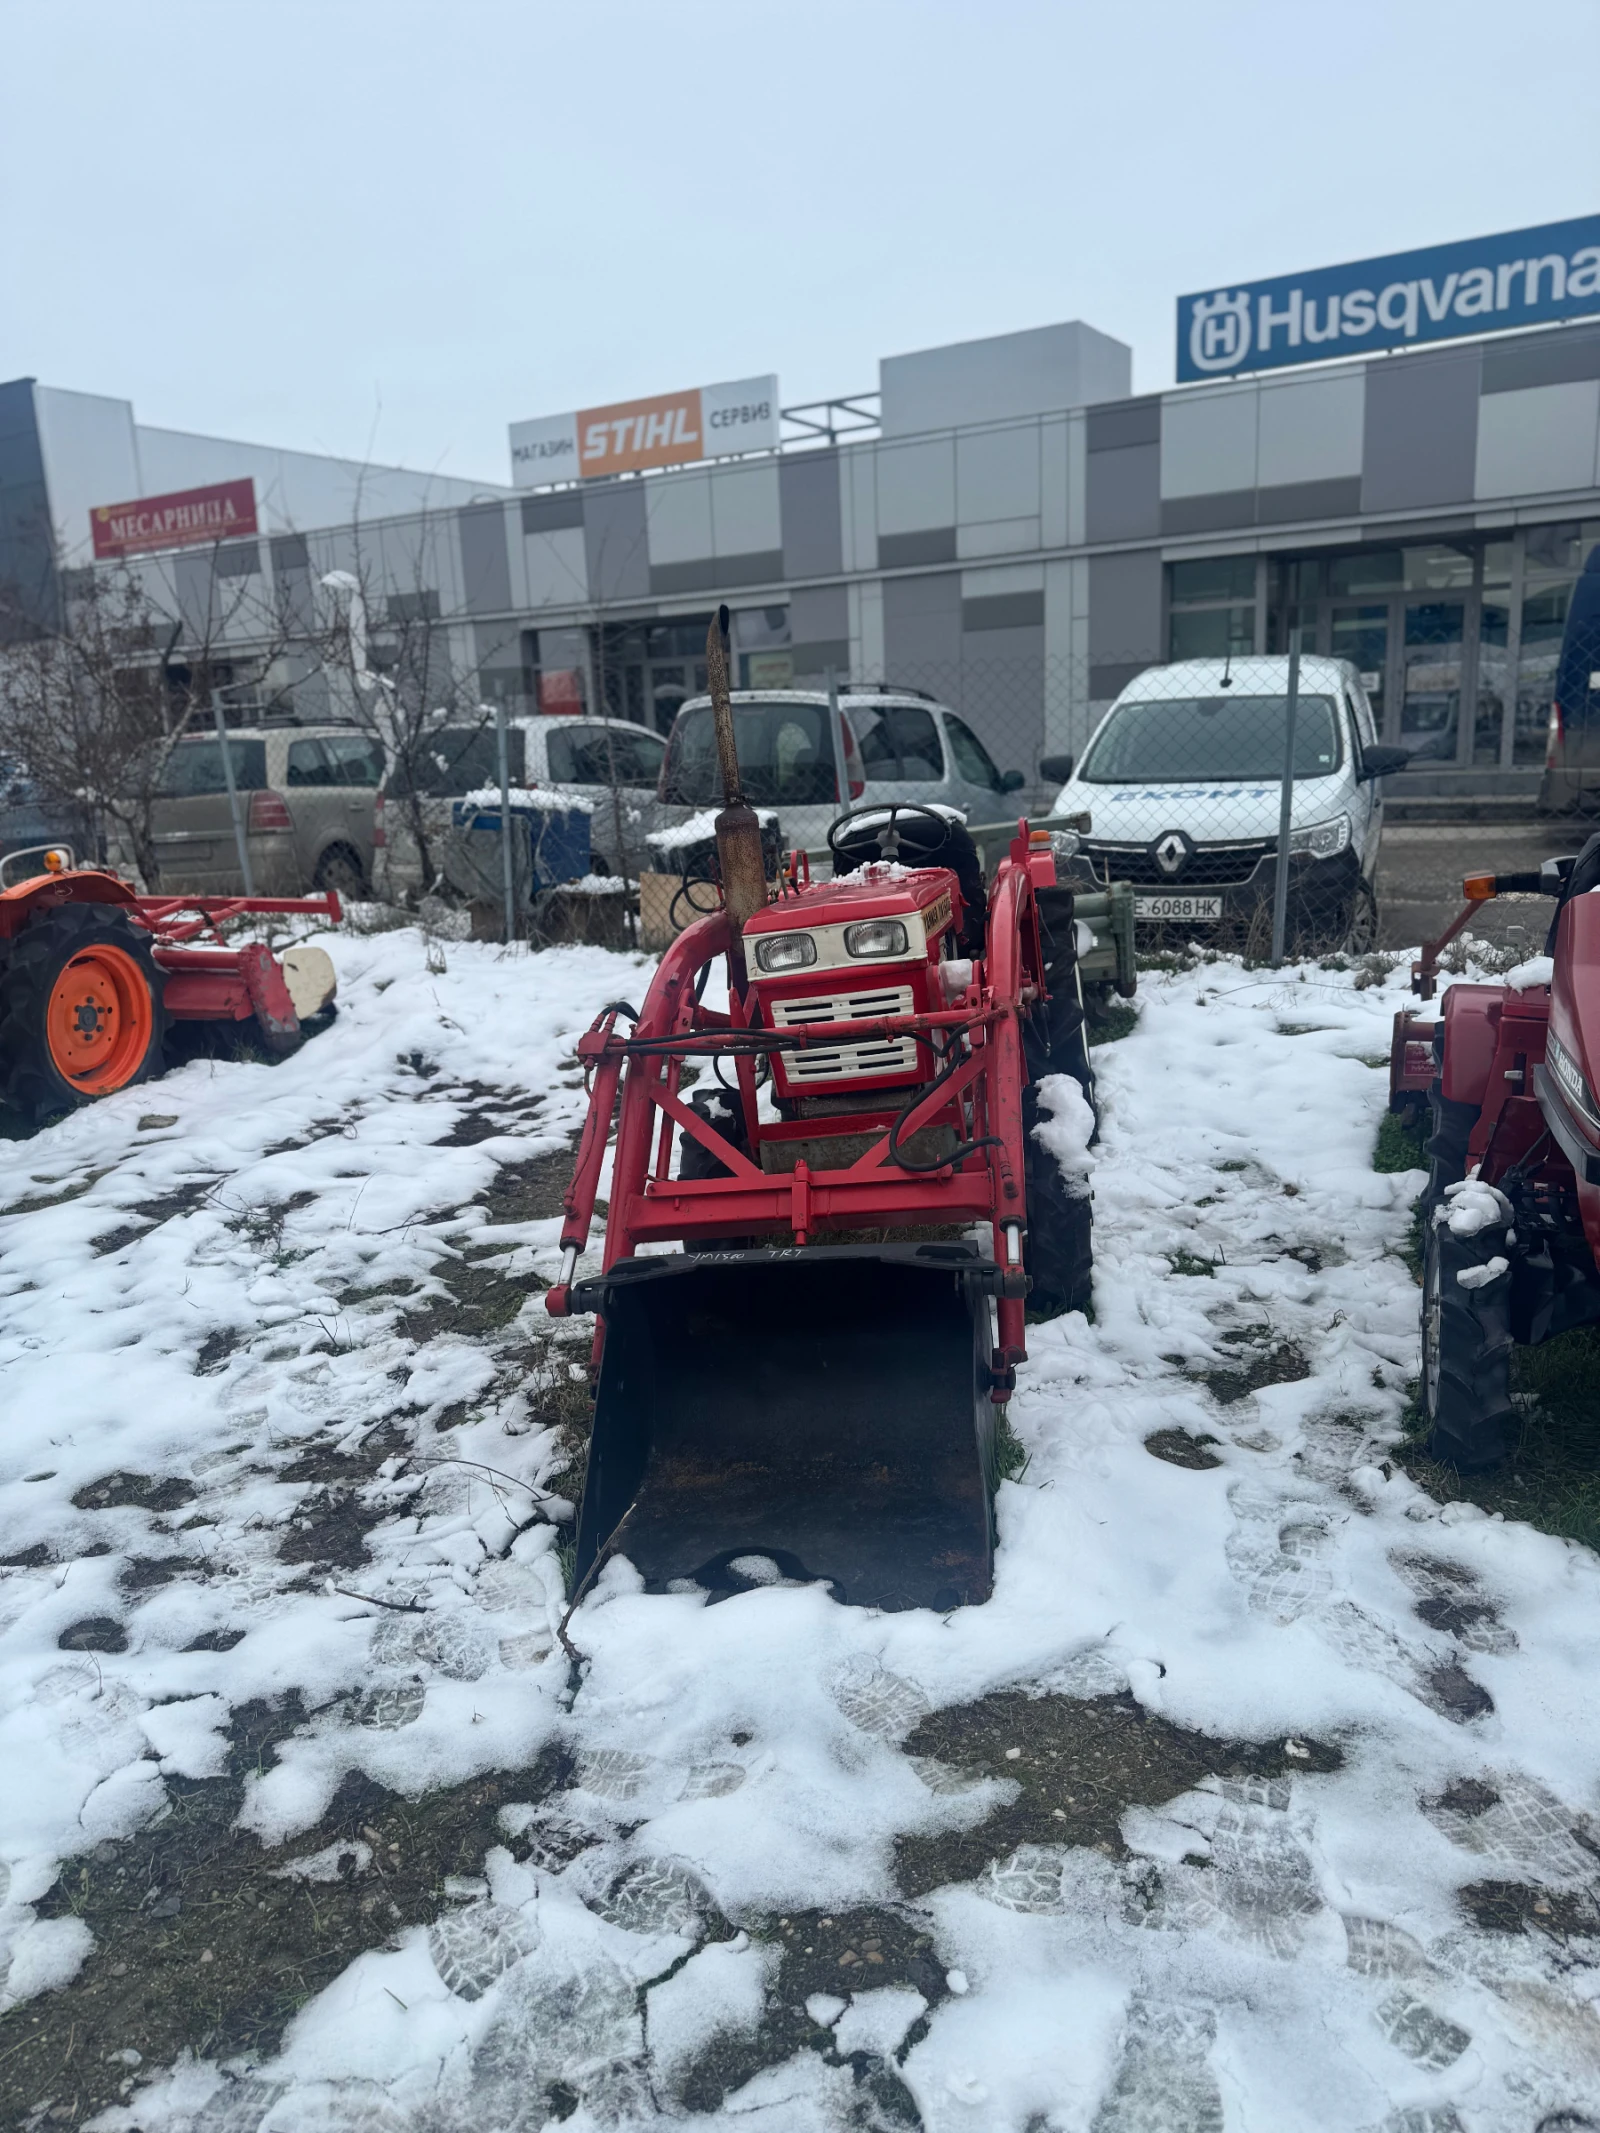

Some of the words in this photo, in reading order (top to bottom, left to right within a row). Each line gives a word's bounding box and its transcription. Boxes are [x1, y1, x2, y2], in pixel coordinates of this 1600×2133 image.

[1258, 246, 1600, 351] Husqvarna
[709, 401, 772, 429] СЕРВИЗ
[513, 438, 574, 464] МАГАЗИН
[583, 407, 699, 460] STIHL
[110, 498, 237, 540] МЕСАРНИЦА
[1151, 900, 1192, 916] 6088
[1195, 900, 1216, 915] HK
[1558, 1051, 1583, 1098] HONDA
[768, 1249, 809, 1258] TRT
